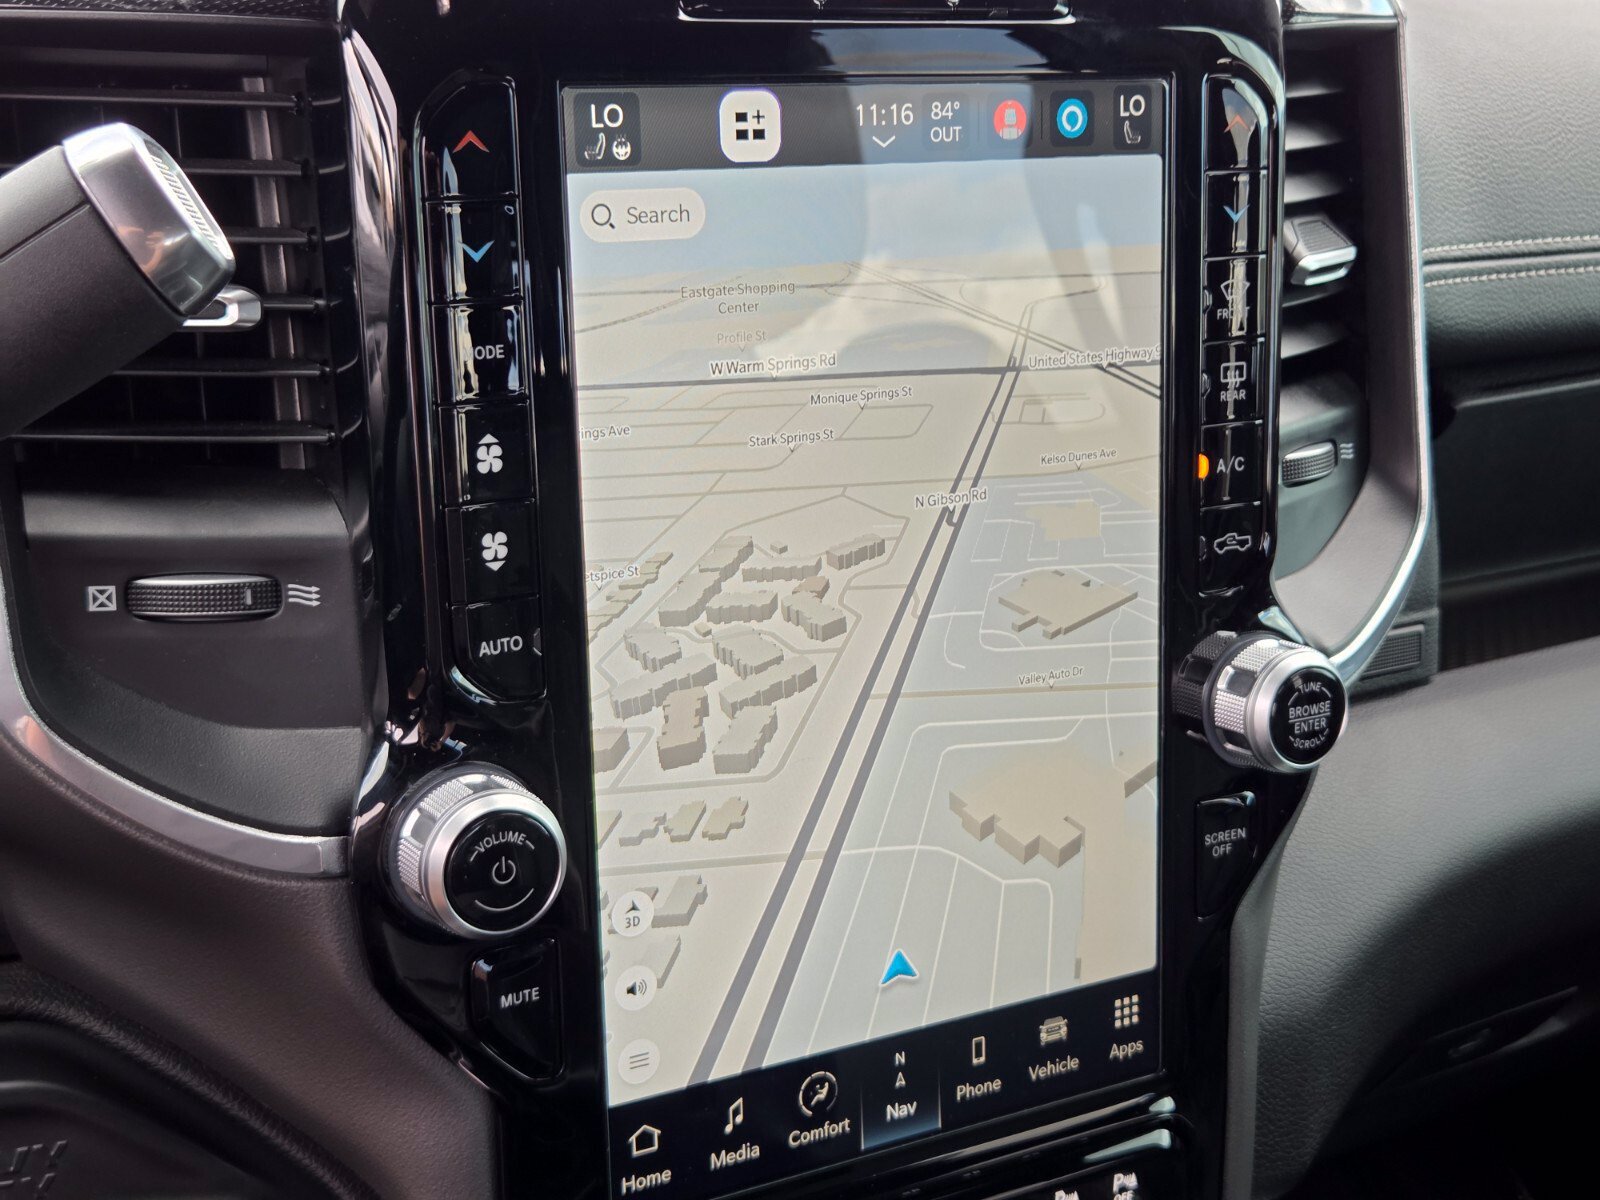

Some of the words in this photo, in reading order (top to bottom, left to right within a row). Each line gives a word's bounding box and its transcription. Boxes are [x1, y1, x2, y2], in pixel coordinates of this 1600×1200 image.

[856, 103, 914, 126] 11:16
[930, 101, 961, 120] 84°
[1119, 94, 1146, 117] LO
[590, 103, 624, 128] LO
[930, 126, 962, 143] OUT
[627, 204, 691, 224] Search
[681, 285, 734, 300] Eastgate
[737, 281, 796, 298] Shopping
[718, 301, 760, 314] Center
[717, 331, 752, 344] Profile
[754, 330, 767, 341] St
[710, 363, 723, 375] W
[726, 360, 765, 374] Warm
[768, 356, 817, 373] Springs
[820, 353, 837, 367] Rd
[1029, 352, 1067, 368] United
[1068, 350, 1103, 364] States
[1106, 346, 1154, 361] Highway
[810, 392, 858, 406] Monique
[860, 388, 900, 402] Springs
[901, 386, 913, 398] St
[1220, 389, 1246, 402] REAR
[608, 425, 630, 437] Ave
[749, 434, 778, 447] Stark
[780, 430, 822, 446] Springs
[824, 429, 834, 440] St
[1041, 454, 1066, 465] Kelso
[1069, 450, 1097, 462] Dunes
[1099, 448, 1117, 459] Ave
[1216, 455, 1245, 474] A/C
[915, 496, 925, 508] N
[927, 491, 967, 507] Gibson
[971, 488, 988, 501] Rd
[627, 565, 639, 577] St
[479, 635, 523, 658] AUTO
[1019, 673, 1046, 685] Valley
[1048, 669, 1070, 680] Auto
[1072, 666, 1083, 676] Dr
[1299, 681, 1322, 694] TUNE
[1288, 701, 1331, 717] BROWSE
[1294, 718, 1327, 734] ENTER
[1293, 733, 1326, 749] SCROLL
[475, 830, 526, 853] VOLUME
[1204, 827, 1246, 846] SCREEN
[1212, 843, 1233, 857] OFF
[625, 916, 641, 929] 3D
[500, 986, 540, 1008] MUTE
[1109, 1039, 1144, 1061] Apps
[1028, 1055, 1080, 1081] Vehicle
[956, 1078, 1002, 1102] Phone
[886, 1100, 918, 1122] Nav
[788, 1117, 851, 1148] Comfort
[709, 1142, 761, 1170] Media
[621, 1167, 672, 1196] Home
